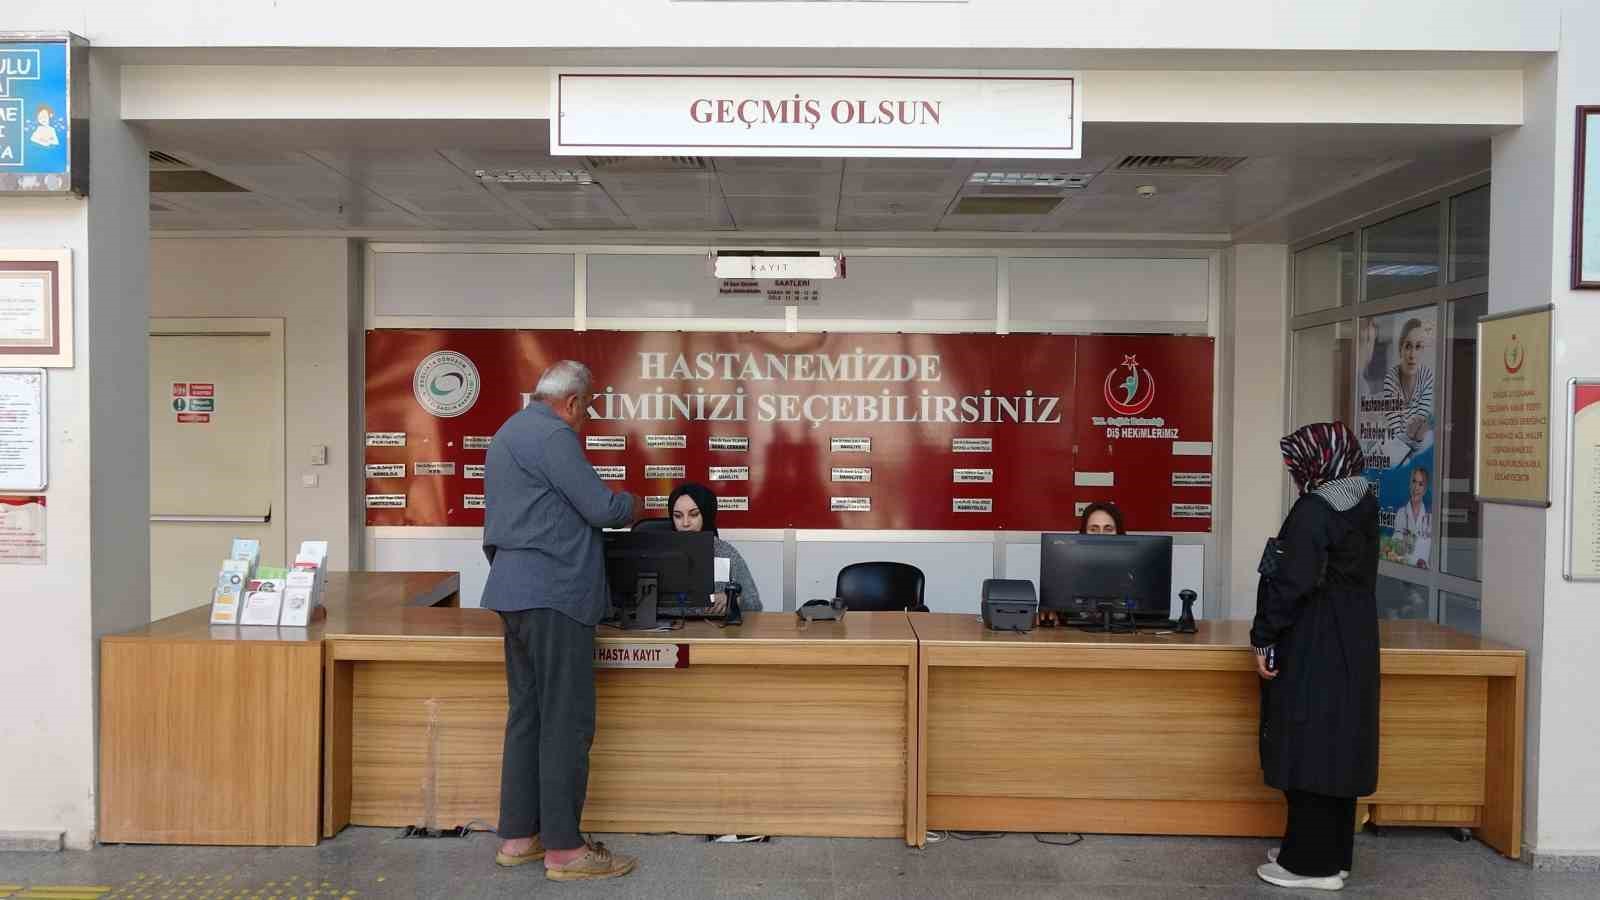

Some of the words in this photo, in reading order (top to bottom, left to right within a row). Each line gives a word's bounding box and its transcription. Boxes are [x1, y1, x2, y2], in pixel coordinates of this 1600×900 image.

[690, 94, 821, 130] GEÇMİŞ
[831, 99, 943, 126] OLSUN
[751, 263, 789, 273] KAYIT
[639, 347, 942, 382] HASTANEMİZDE
[757, 388, 1061, 428] SEÇEBİLİRSİNİZ
[599, 648, 630, 661] HASTA
[632, 648, 662, 661] KAYIT
